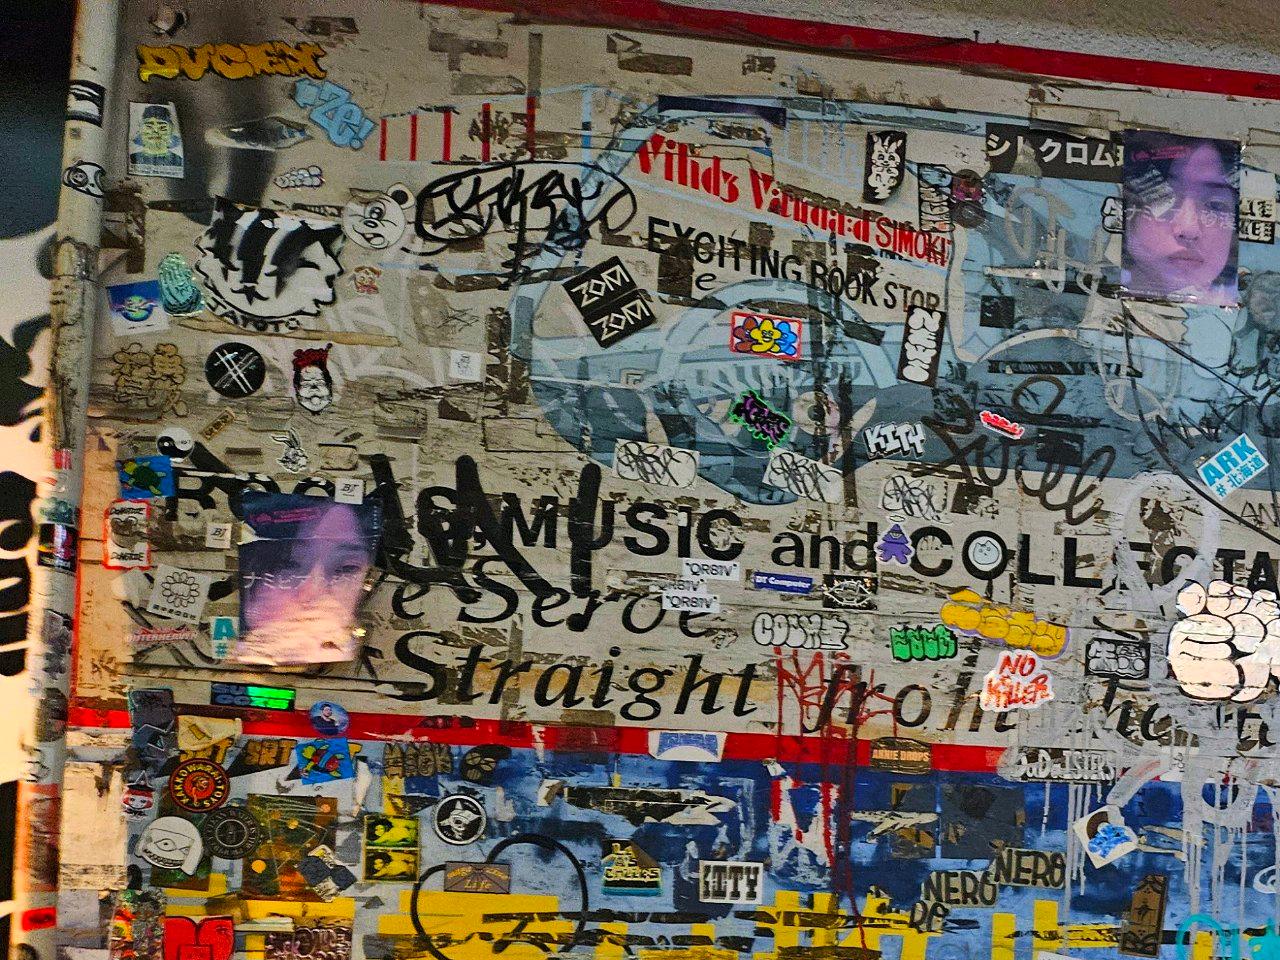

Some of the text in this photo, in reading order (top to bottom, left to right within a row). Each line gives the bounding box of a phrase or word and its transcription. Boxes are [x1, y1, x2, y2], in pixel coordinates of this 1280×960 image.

[648, 215, 802, 288] EXCITING
[811, 261, 878, 307] BOOK
[570, 264, 631, 308] ZOM
[590, 298, 651, 342] ZOM
[1201, 436, 1258, 487] ARK
[500, 491, 745, 560] MUSIC
[770, 521, 878, 573] and
[768, 576, 812, 589] Computer
[388, 629, 759, 722] Straight
[999, 654, 1036, 676] NO
[900, 750, 931, 761] DROPS
[923, 870, 997, 906] NERO
[994, 850, 1067, 888] NERO
